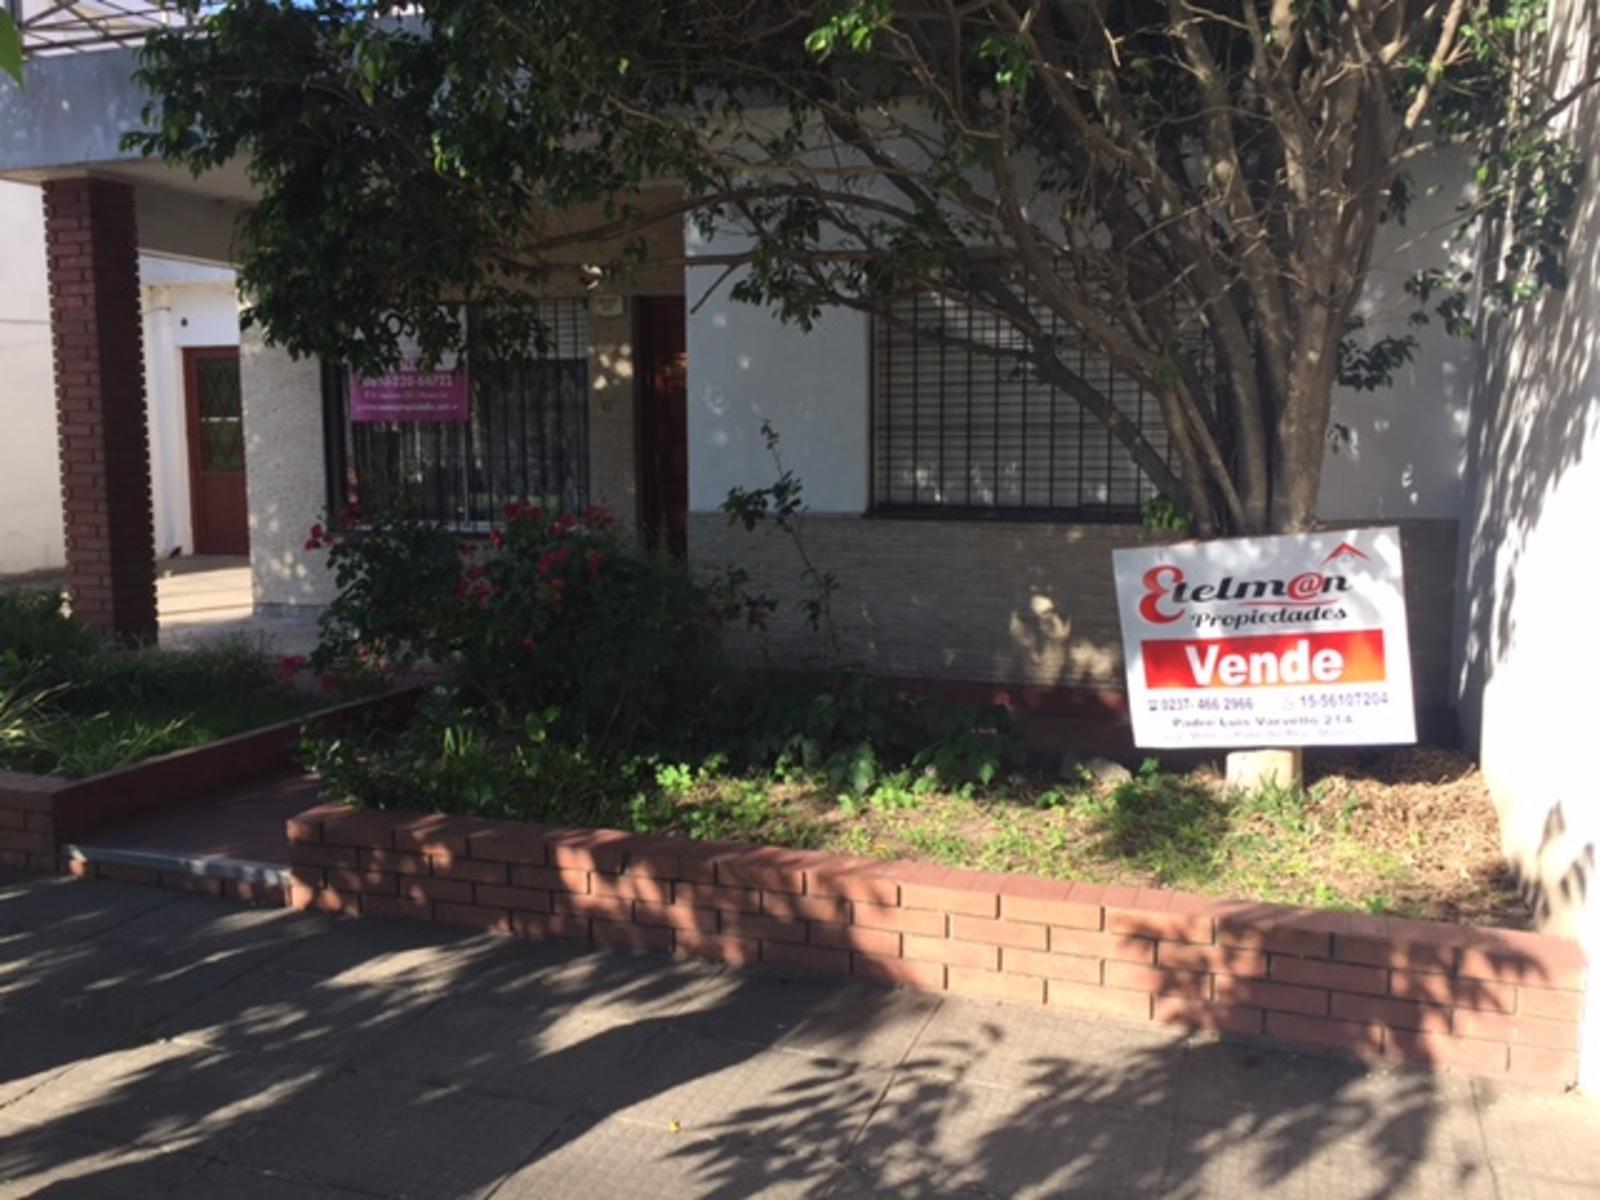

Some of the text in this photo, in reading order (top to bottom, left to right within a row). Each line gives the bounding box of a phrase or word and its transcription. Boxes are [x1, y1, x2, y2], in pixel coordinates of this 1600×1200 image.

[1139, 564, 1351, 624] Etelm@n
[1191, 607, 1347, 630] Propiedades
[1185, 640, 1344, 687] Vende
[1197, 697, 1220, 711] 466
[1223, 696, 1254, 711] 2966
[1172, 717, 1215, 728] Padre
[1219, 716, 1250, 727] Luis
[1324, 714, 1353, 726] 214
